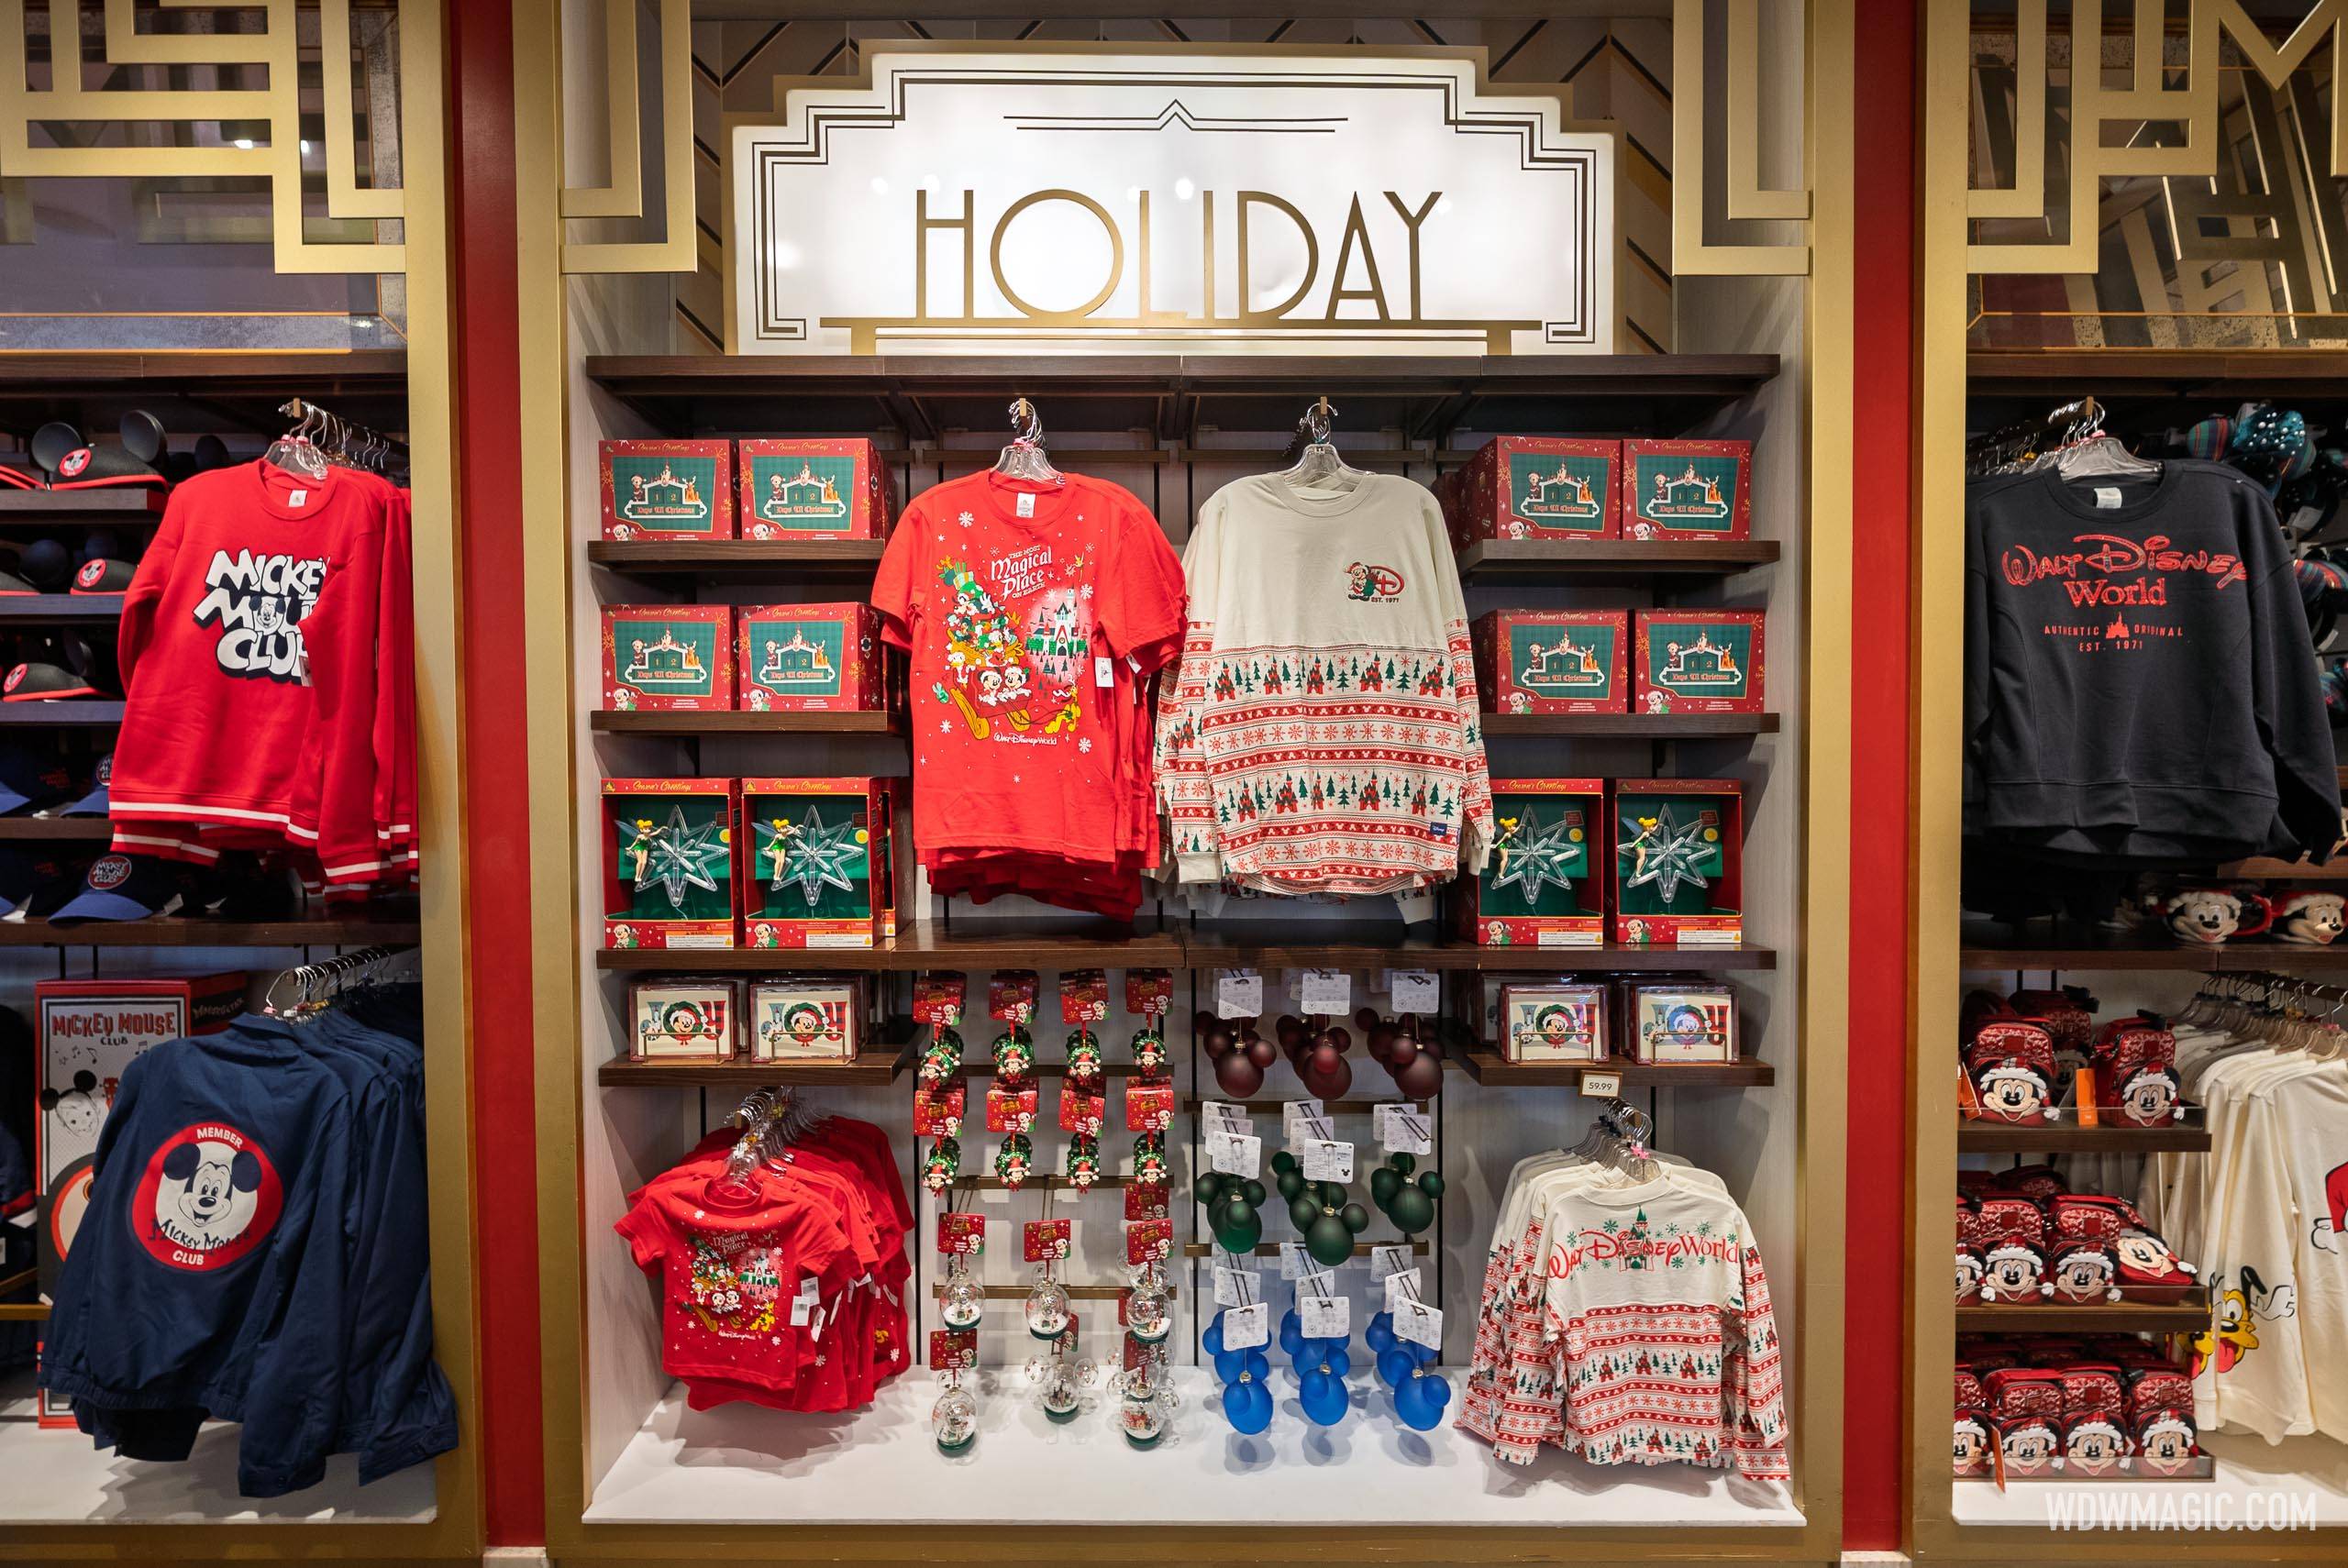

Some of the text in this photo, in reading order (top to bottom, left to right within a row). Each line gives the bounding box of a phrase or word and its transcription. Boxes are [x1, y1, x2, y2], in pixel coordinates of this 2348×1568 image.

[915, 188, 1444, 320] HOLIDAY
[1023, 545, 1041, 556] MOST
[991, 546, 1052, 581] Magical
[205, 547, 330, 601] MICKE
[1001, 569, 1045, 602] Place
[2064, 577, 2167, 608] World
[193, 587, 319, 637] MOU
[2043, 624, 2183, 636] AUTHENTIC ORIGINAL
[2079, 640, 2143, 652] EST. 1971
[632, 779, 692, 791] Season's Greetings
[773, 779, 832, 792] Season's Greetings
[1509, 779, 1567, 791] Season's Greetings
[51, 1012, 176, 1038] MICKEY MOUSE
[100, 1036, 128, 1046] CLUB
[1589, 1082, 1612, 1091] 59.99
[196, 1127, 243, 1149] MEMBER
[172, 1249, 205, 1265] CLUB
[1679, 1234, 1739, 1264] World
